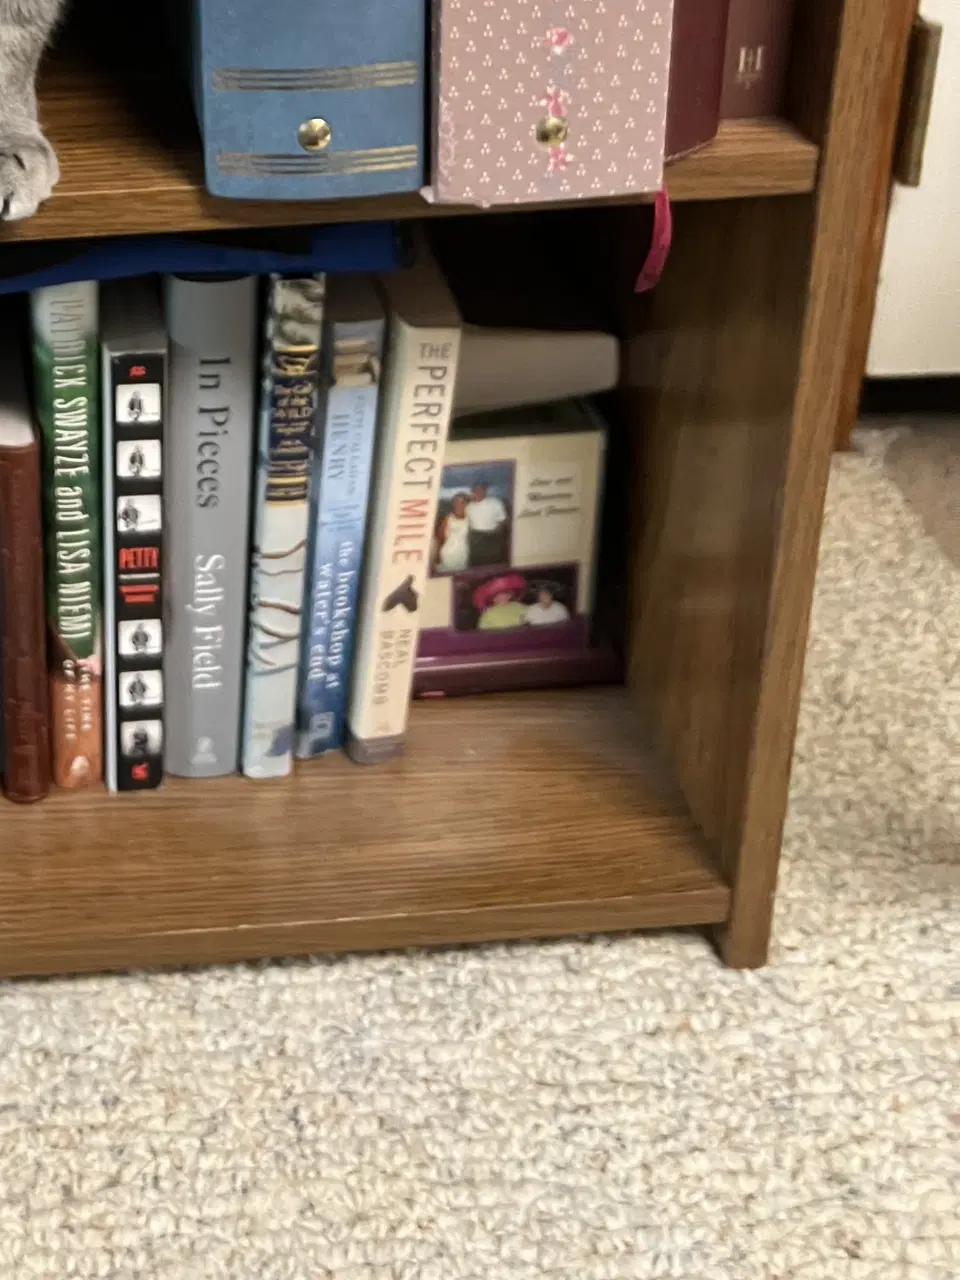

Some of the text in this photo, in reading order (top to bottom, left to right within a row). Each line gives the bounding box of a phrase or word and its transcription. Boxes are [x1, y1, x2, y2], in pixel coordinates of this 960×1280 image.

[419, 342, 452, 360] THE
[52, 395, 89, 478] SWAYZE
[196, 357, 232, 509] In Pieces
[392, 366, 448, 565] PERFECT MILE
[55, 485, 90, 522] and
[56, 528, 91, 574] LISA
[339, 540, 354, 566] the
[185, 554, 226, 688] Sally Field
[326, 571, 354, 669] bookshop
[395, 628, 414, 668] NEAL
